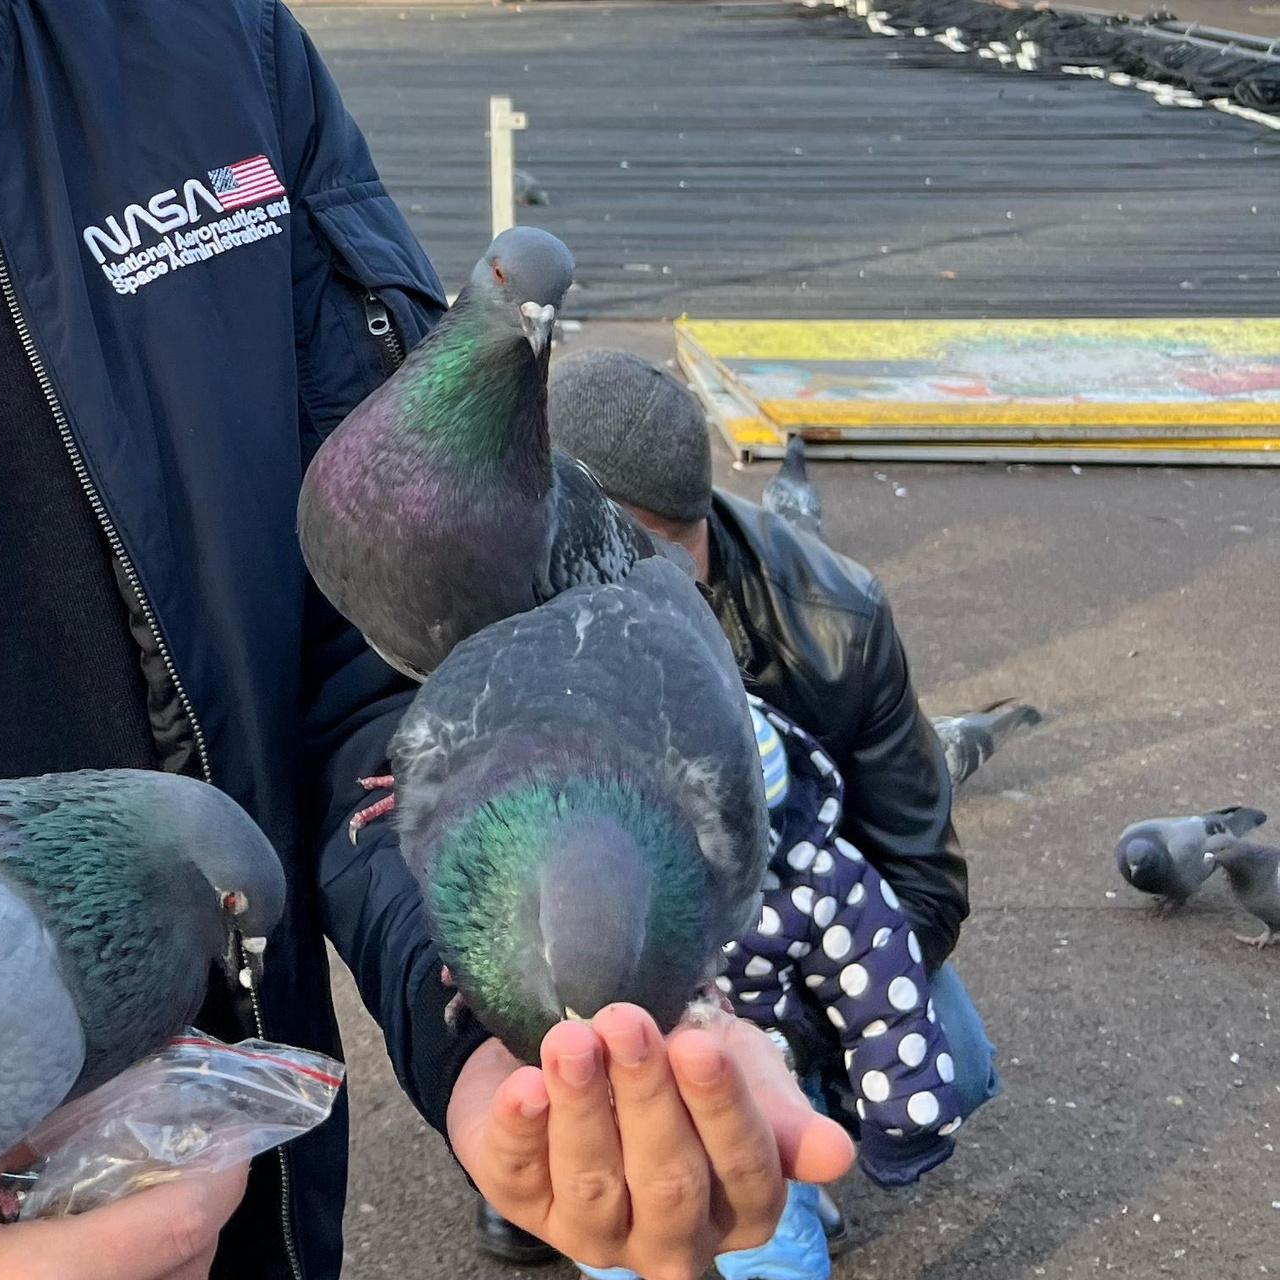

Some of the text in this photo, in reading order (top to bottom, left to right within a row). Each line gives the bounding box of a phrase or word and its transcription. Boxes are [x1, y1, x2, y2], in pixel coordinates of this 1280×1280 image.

[83, 179, 224, 264] NASA
[102, 196, 291, 281] National Aeronautics and
[113, 261, 168, 294] Space
